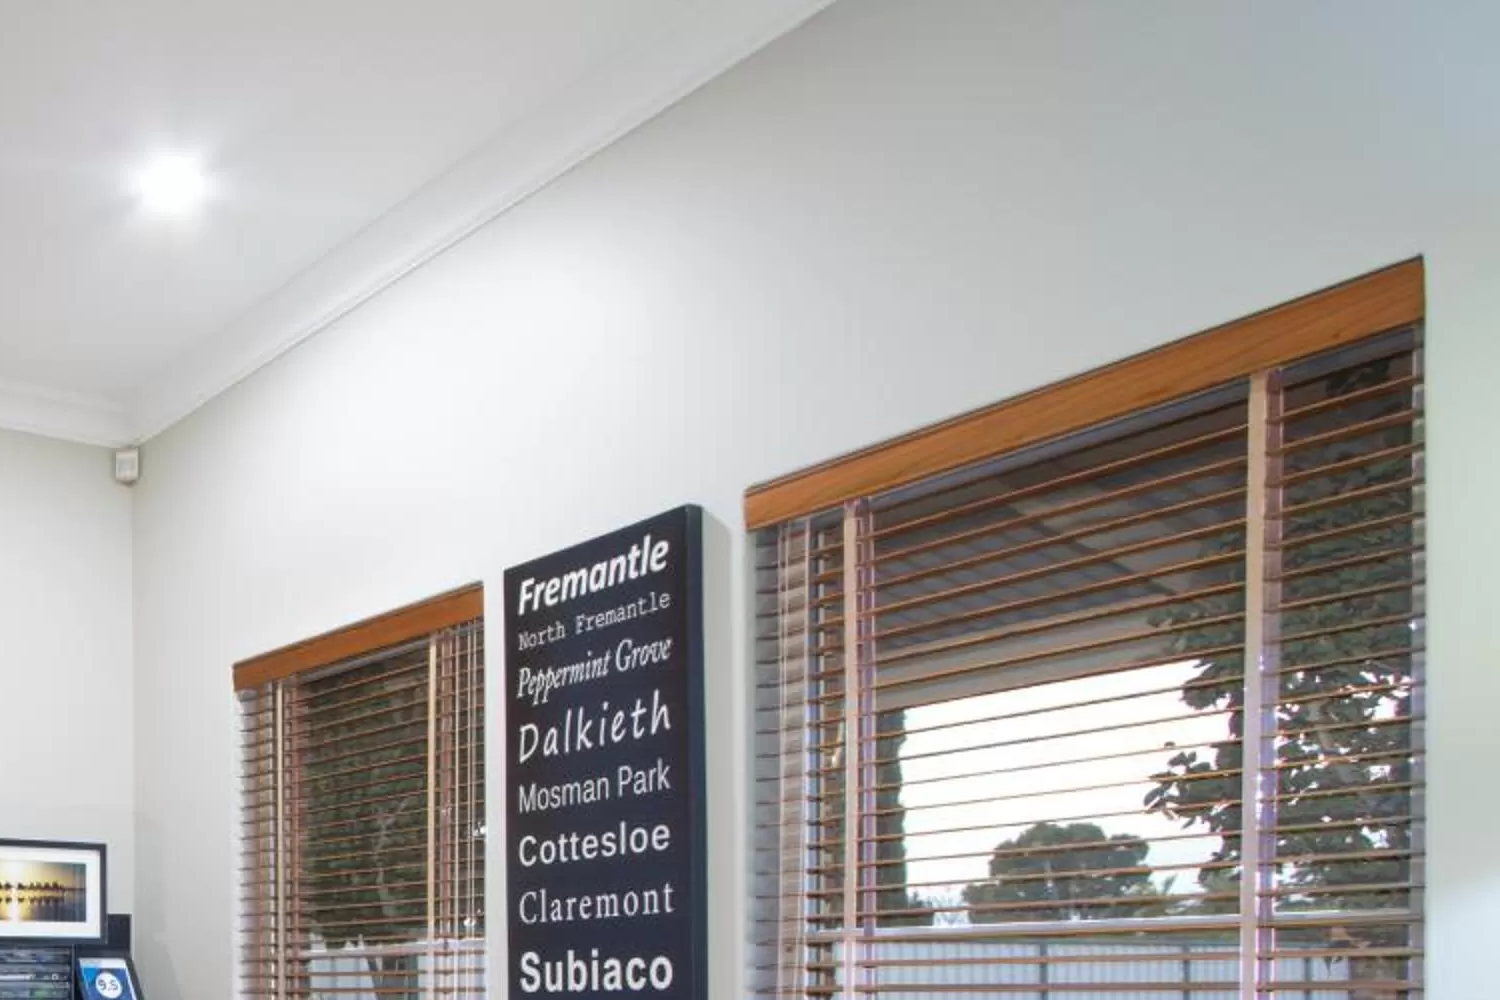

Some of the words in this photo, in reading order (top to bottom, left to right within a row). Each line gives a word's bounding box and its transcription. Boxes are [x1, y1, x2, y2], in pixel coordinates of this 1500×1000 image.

[517, 533, 670, 616] Fremantle
[518, 621, 566, 651] North
[575, 591, 671, 635] Fremantle
[516, 650, 610, 706] Peppermint
[615, 636, 673, 673] Grove
[518, 688, 671, 764] Dalkieth
[518, 776, 610, 813] Mosman
[617, 758, 671, 797] Park
[518, 820, 671, 868] Cottesloe
[519, 882, 675, 925] Claremont
[519, 948, 674, 993] Subiaco
